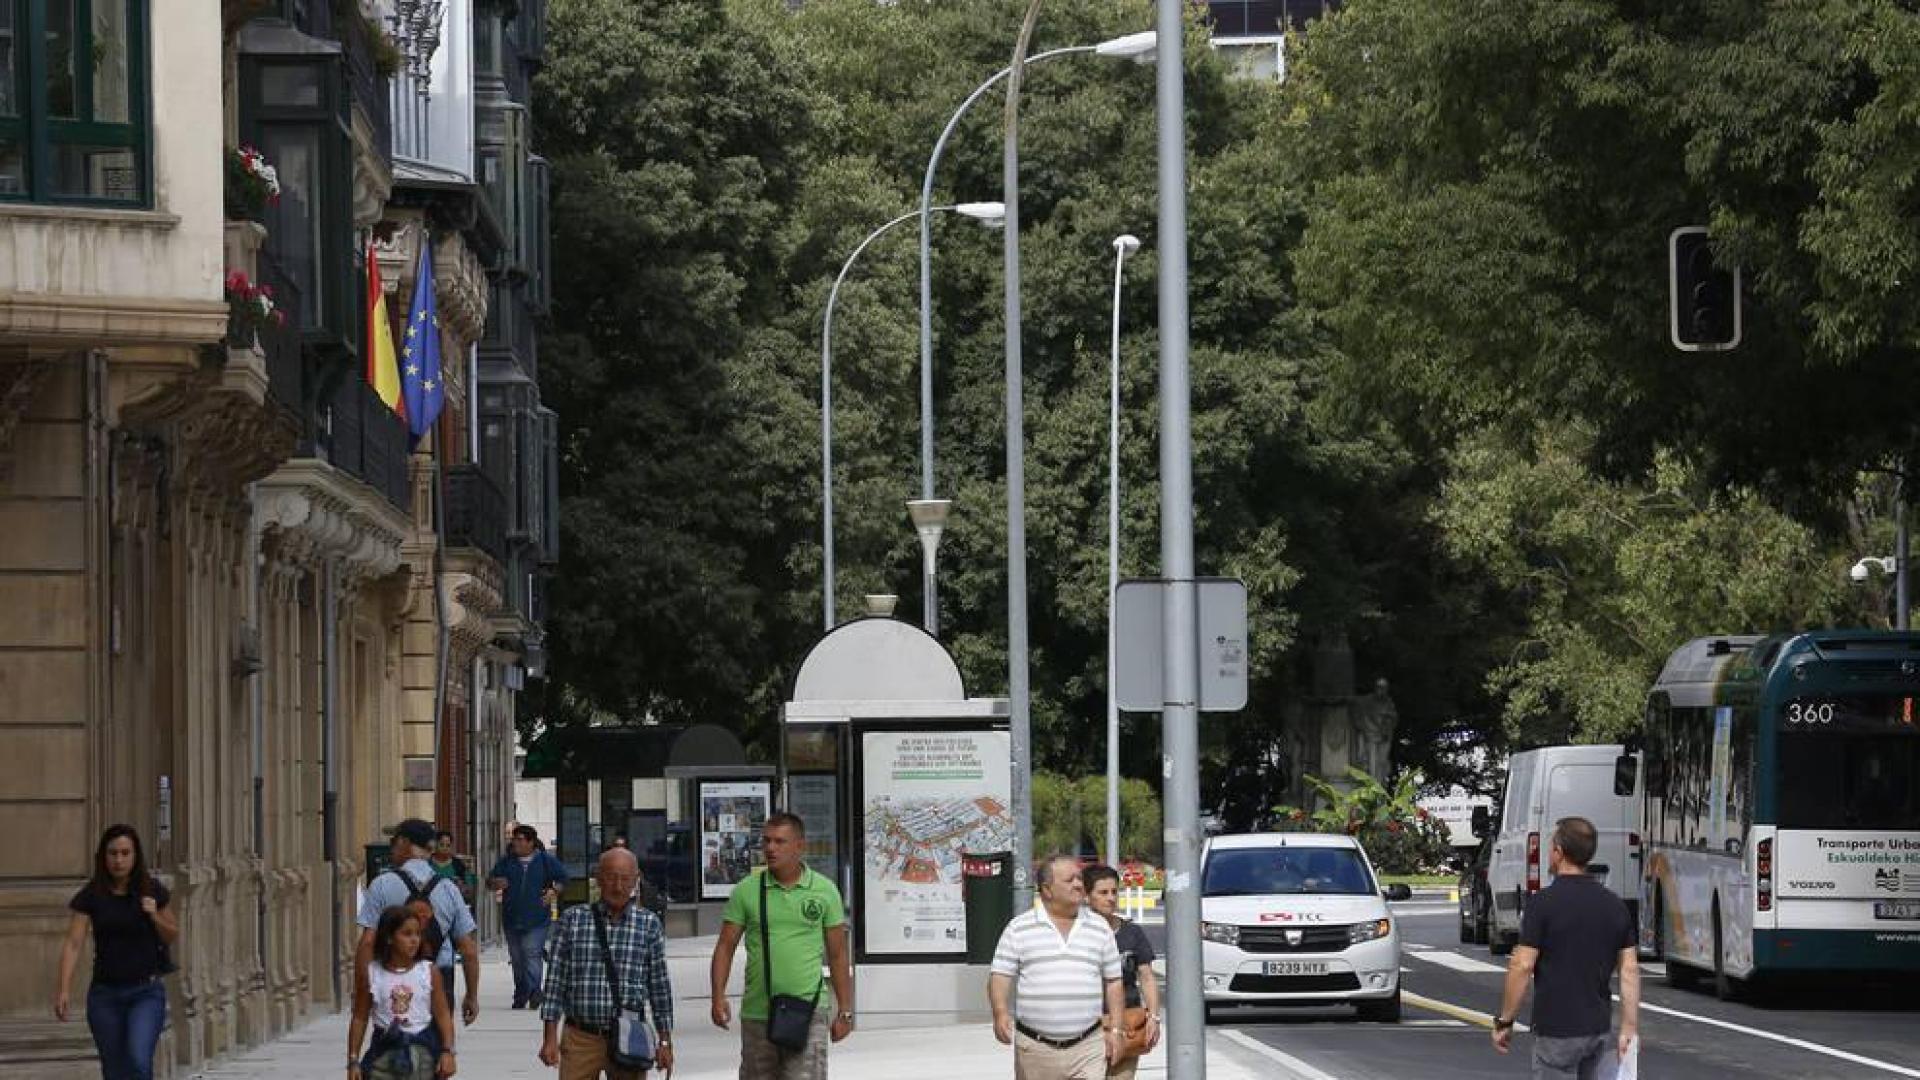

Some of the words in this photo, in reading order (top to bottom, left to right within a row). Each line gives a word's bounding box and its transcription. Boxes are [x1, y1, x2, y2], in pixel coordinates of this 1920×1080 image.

[1817, 837, 1886, 851] Transporte
[1827, 852, 1901, 864] Eskualdeko
[1788, 880, 1836, 889] VOLVO
[1298, 912, 1325, 922] TCC
